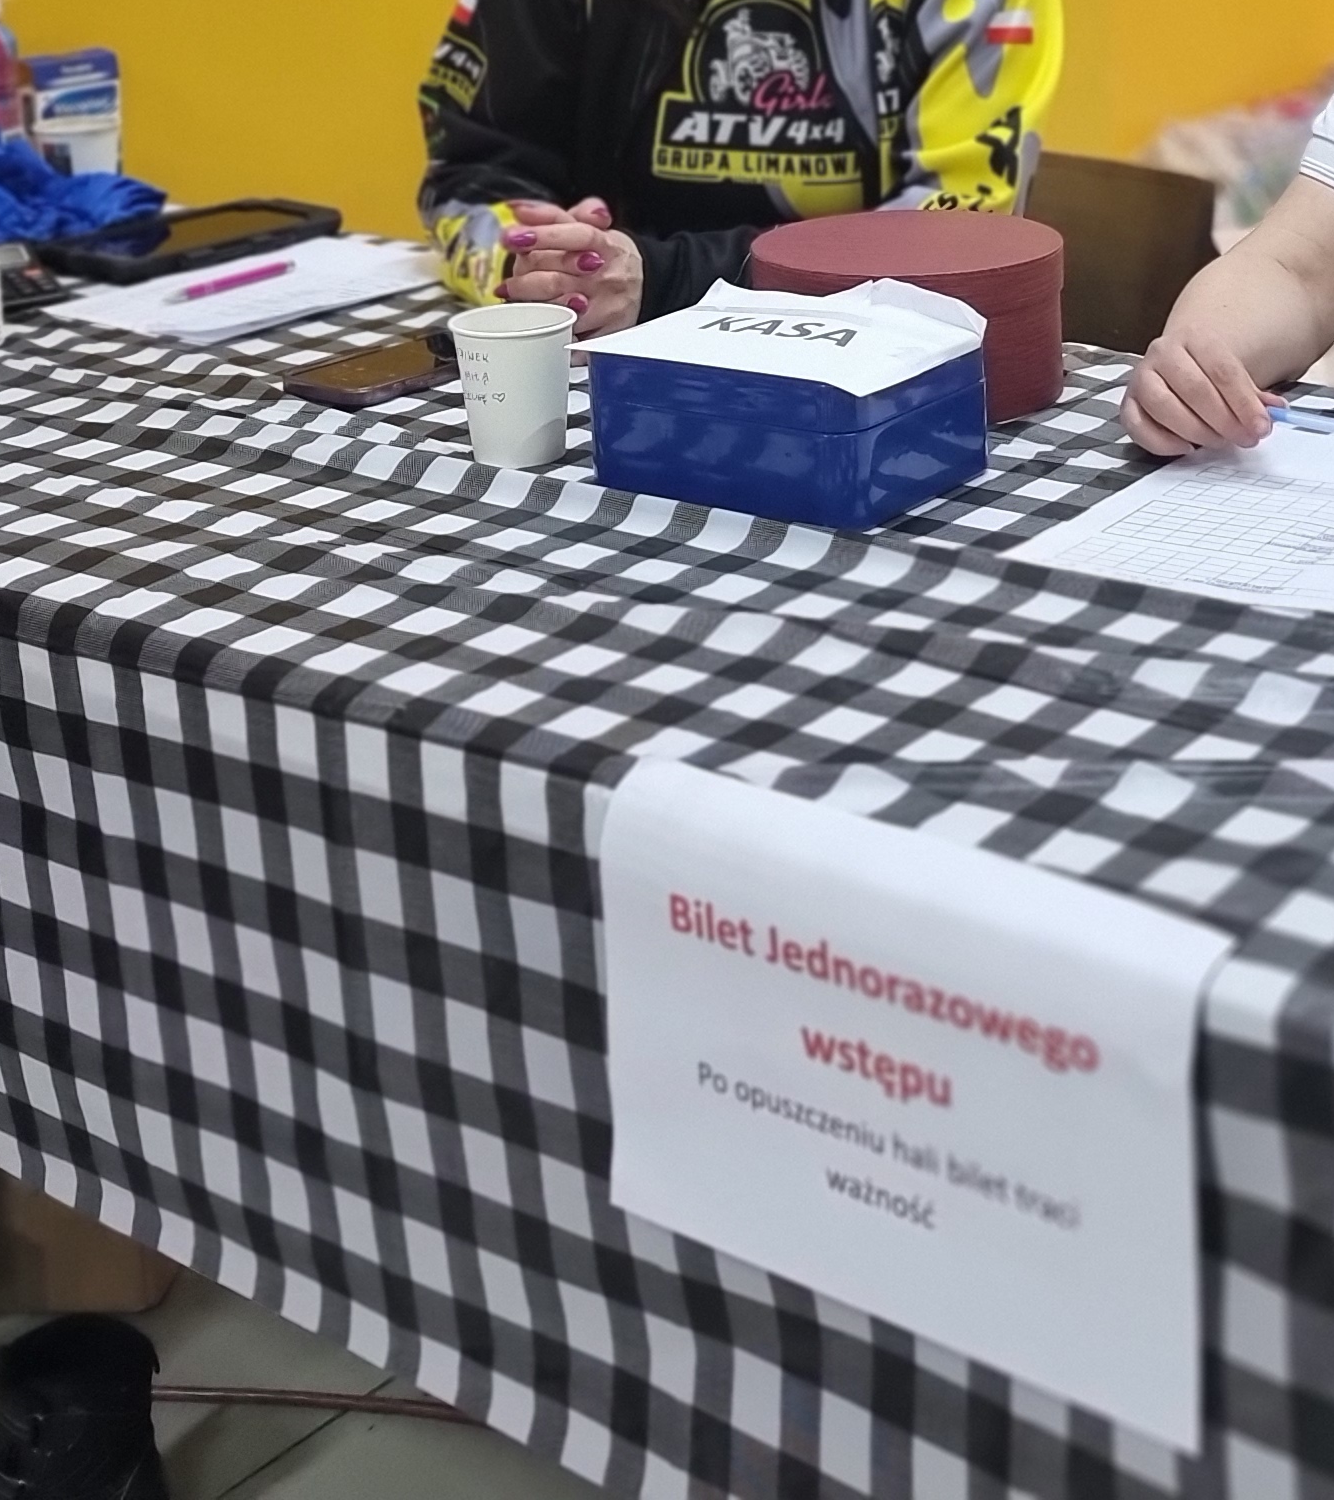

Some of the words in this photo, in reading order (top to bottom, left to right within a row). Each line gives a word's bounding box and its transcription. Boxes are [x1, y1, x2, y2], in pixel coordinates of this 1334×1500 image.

[657, 149, 730, 171] GRUPA
[670, 111, 788, 146] ATV
[787, 117, 845, 145] 4x4
[698, 316, 858, 348] KASA
[668, 892, 756, 957] Bilet
[765, 925, 1101, 1075] Jednorazowego
[800, 1025, 953, 1108] wstępu
[697, 1060, 729, 1095] Po
[733, 1077, 886, 1155] opuszczeniu
[892, 1131, 940, 1175] hali
[946, 1152, 1011, 1204] bilet
[826, 1166, 937, 1231] ważność
